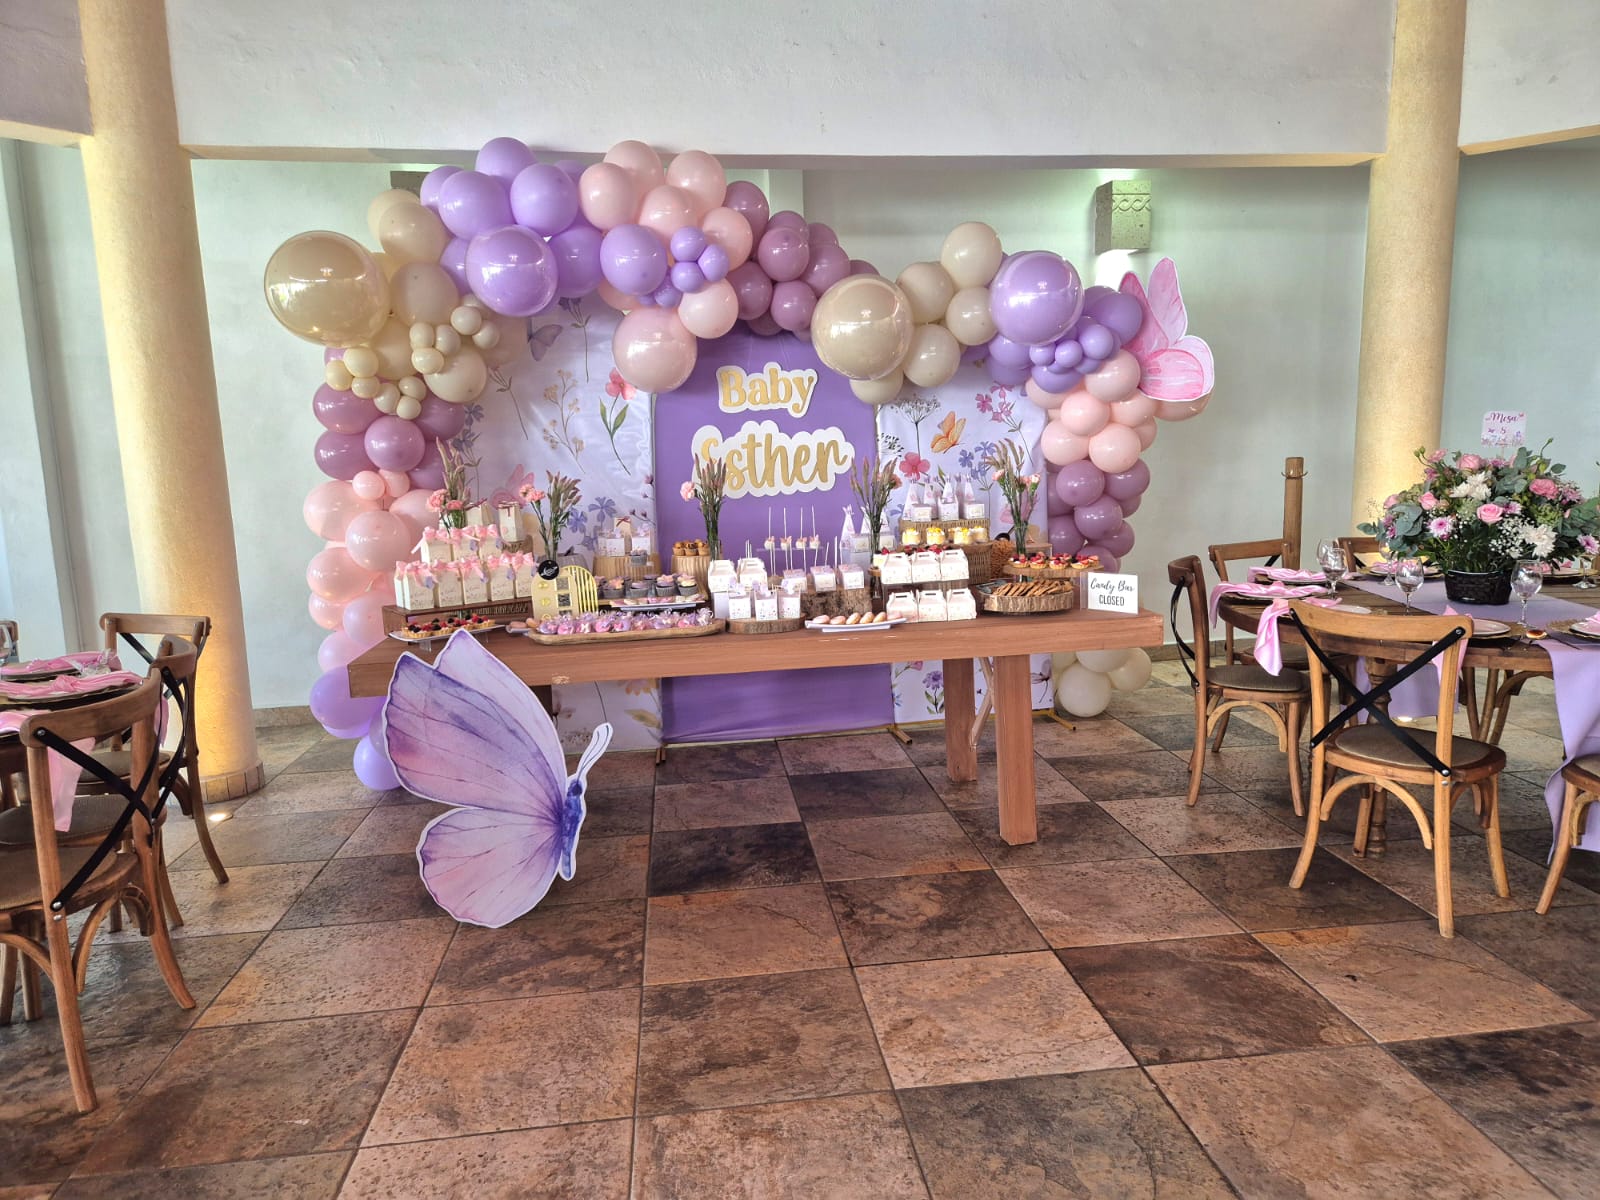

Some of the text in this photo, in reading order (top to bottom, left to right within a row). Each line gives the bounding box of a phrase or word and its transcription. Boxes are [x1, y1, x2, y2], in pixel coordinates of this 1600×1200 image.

[720, 367, 814, 414] Baby
[1490, 412, 1518, 423] Mesa
[1090, 577, 1135, 595] Candy Bar
[1098, 594, 1125, 607] CLOSED
